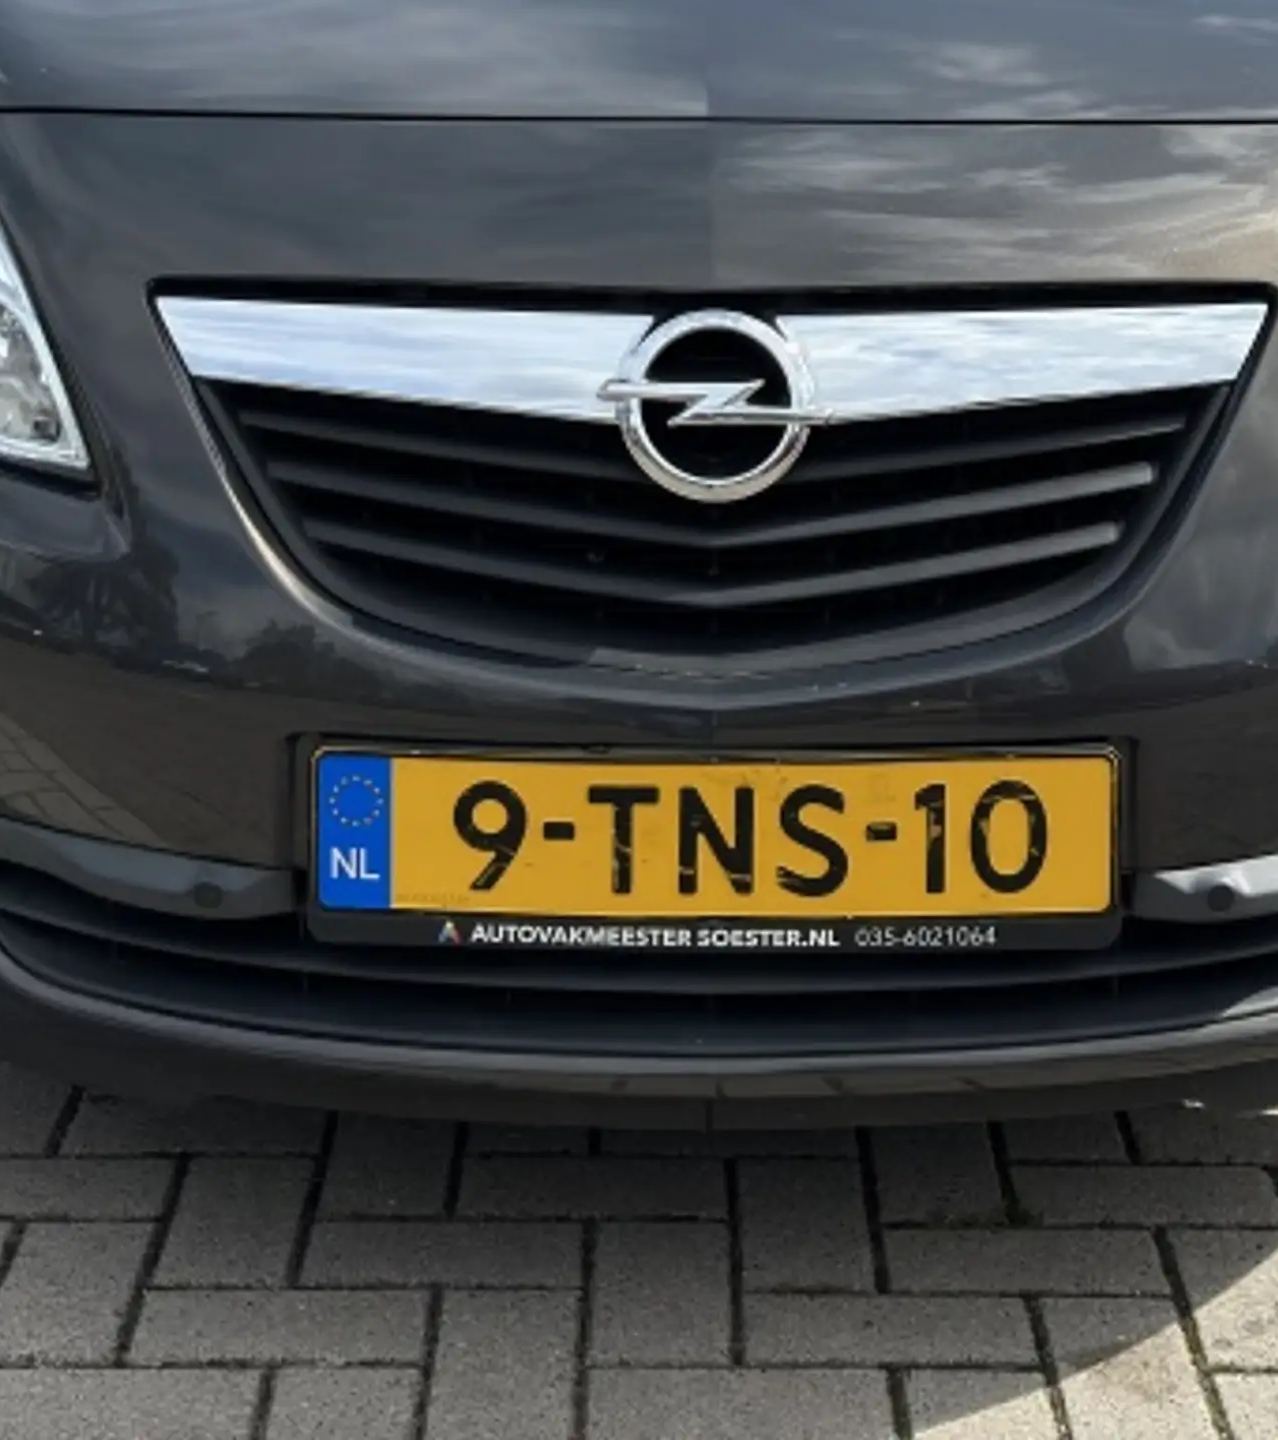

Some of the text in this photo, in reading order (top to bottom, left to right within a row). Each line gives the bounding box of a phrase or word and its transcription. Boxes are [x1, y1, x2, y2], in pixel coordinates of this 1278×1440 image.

[451, 778, 1049, 898] 9-TNS-10
[329, 847, 380, 882] NL
[471, 923, 996, 948] AUTOVAKMEESTER SOESTER.NL 035-6021064
